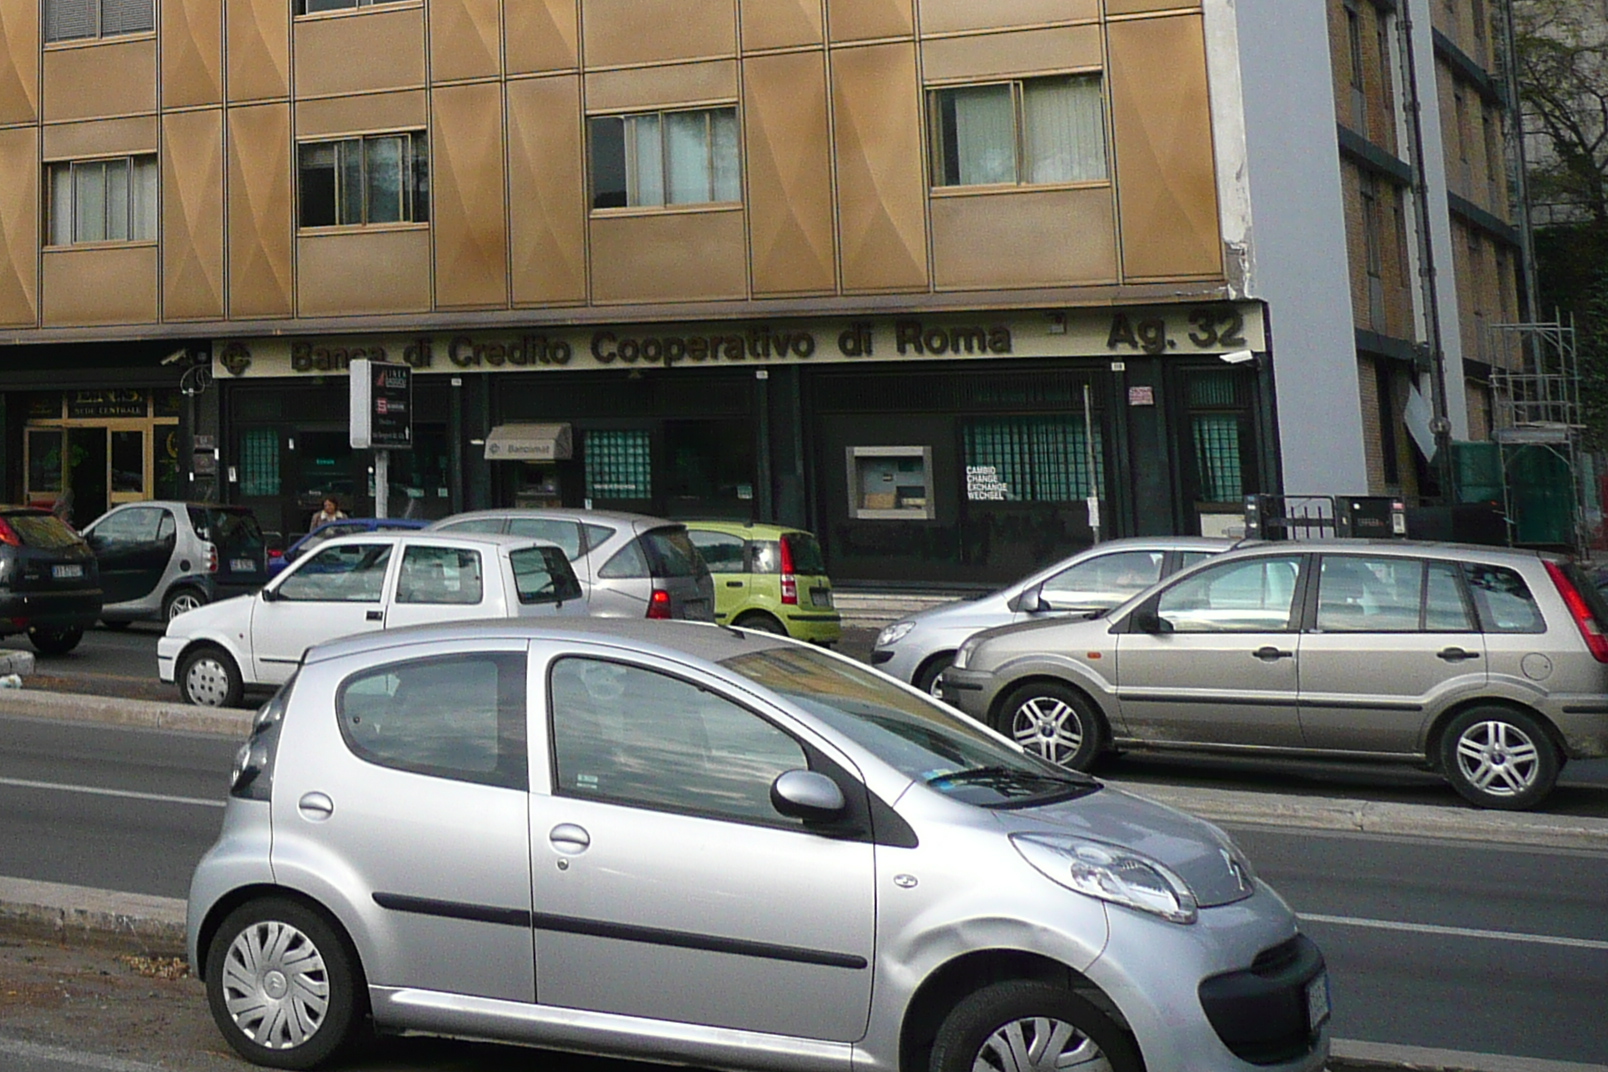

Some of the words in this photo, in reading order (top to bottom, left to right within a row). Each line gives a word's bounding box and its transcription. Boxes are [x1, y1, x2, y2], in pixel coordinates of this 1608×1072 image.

[291, 341, 388, 372] Banca
[403, 337, 432, 369] di
[448, 334, 573, 367] Credito
[591, 328, 817, 367] Cooperativo
[838, 321, 873, 357] di
[896, 321, 1013, 356] Roma
[1106, 312, 1177, 354] Ag.
[1187, 309, 1249, 349] 32
[966, 465, 996, 475] CAMBIO
